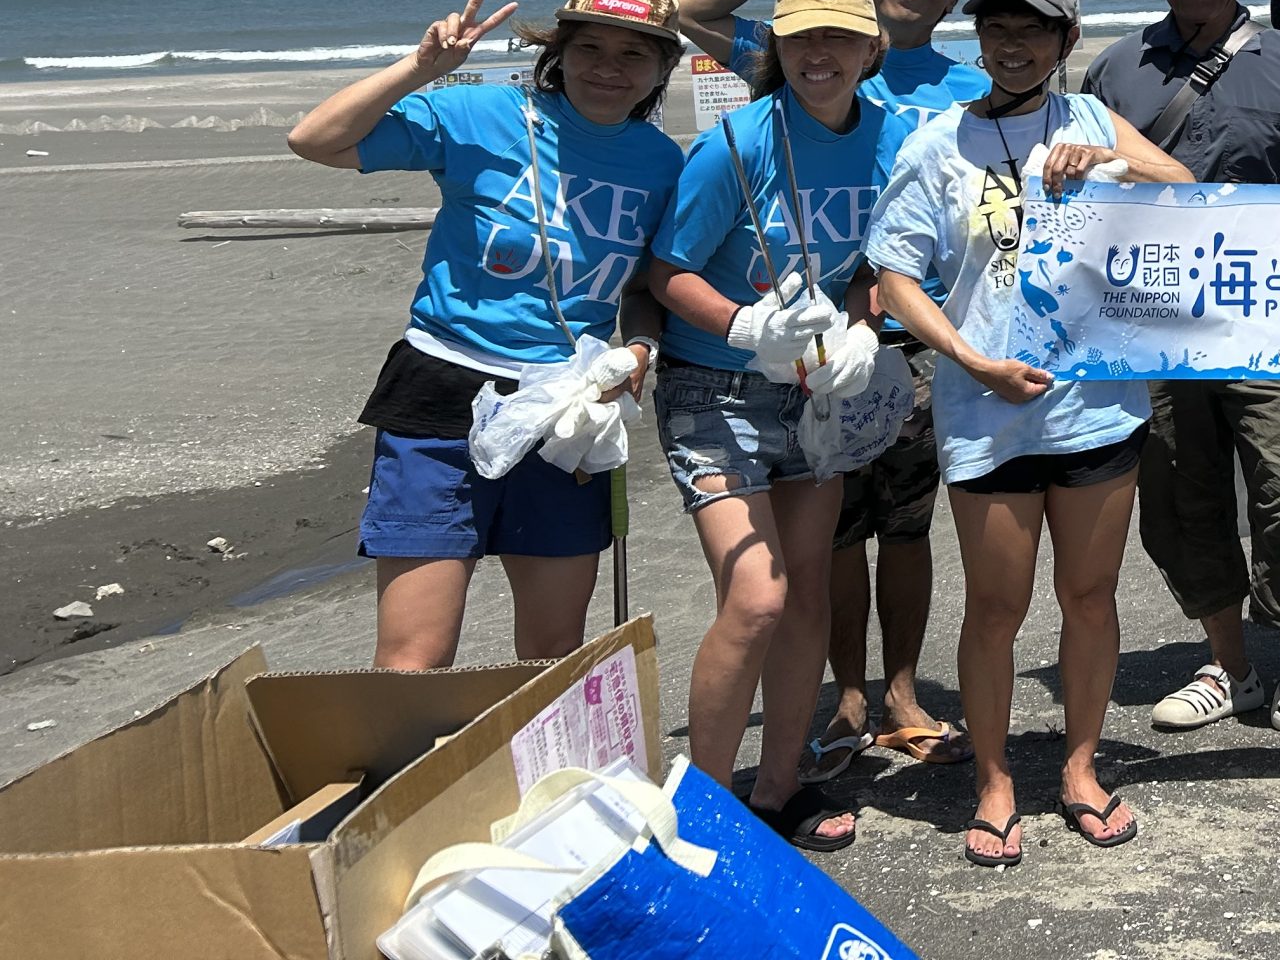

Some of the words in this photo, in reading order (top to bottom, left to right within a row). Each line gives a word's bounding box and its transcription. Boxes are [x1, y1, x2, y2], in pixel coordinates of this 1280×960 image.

[494, 165, 650, 247] AKE
[753, 185, 880, 246] AKE
[1143, 244, 1180, 263] 日本
[990, 257, 1017, 272] SIN
[1103, 292, 1127, 303] THE
[1130, 291, 1180, 304] NIPPON
[1099, 306, 1180, 319] FOUNDATION
